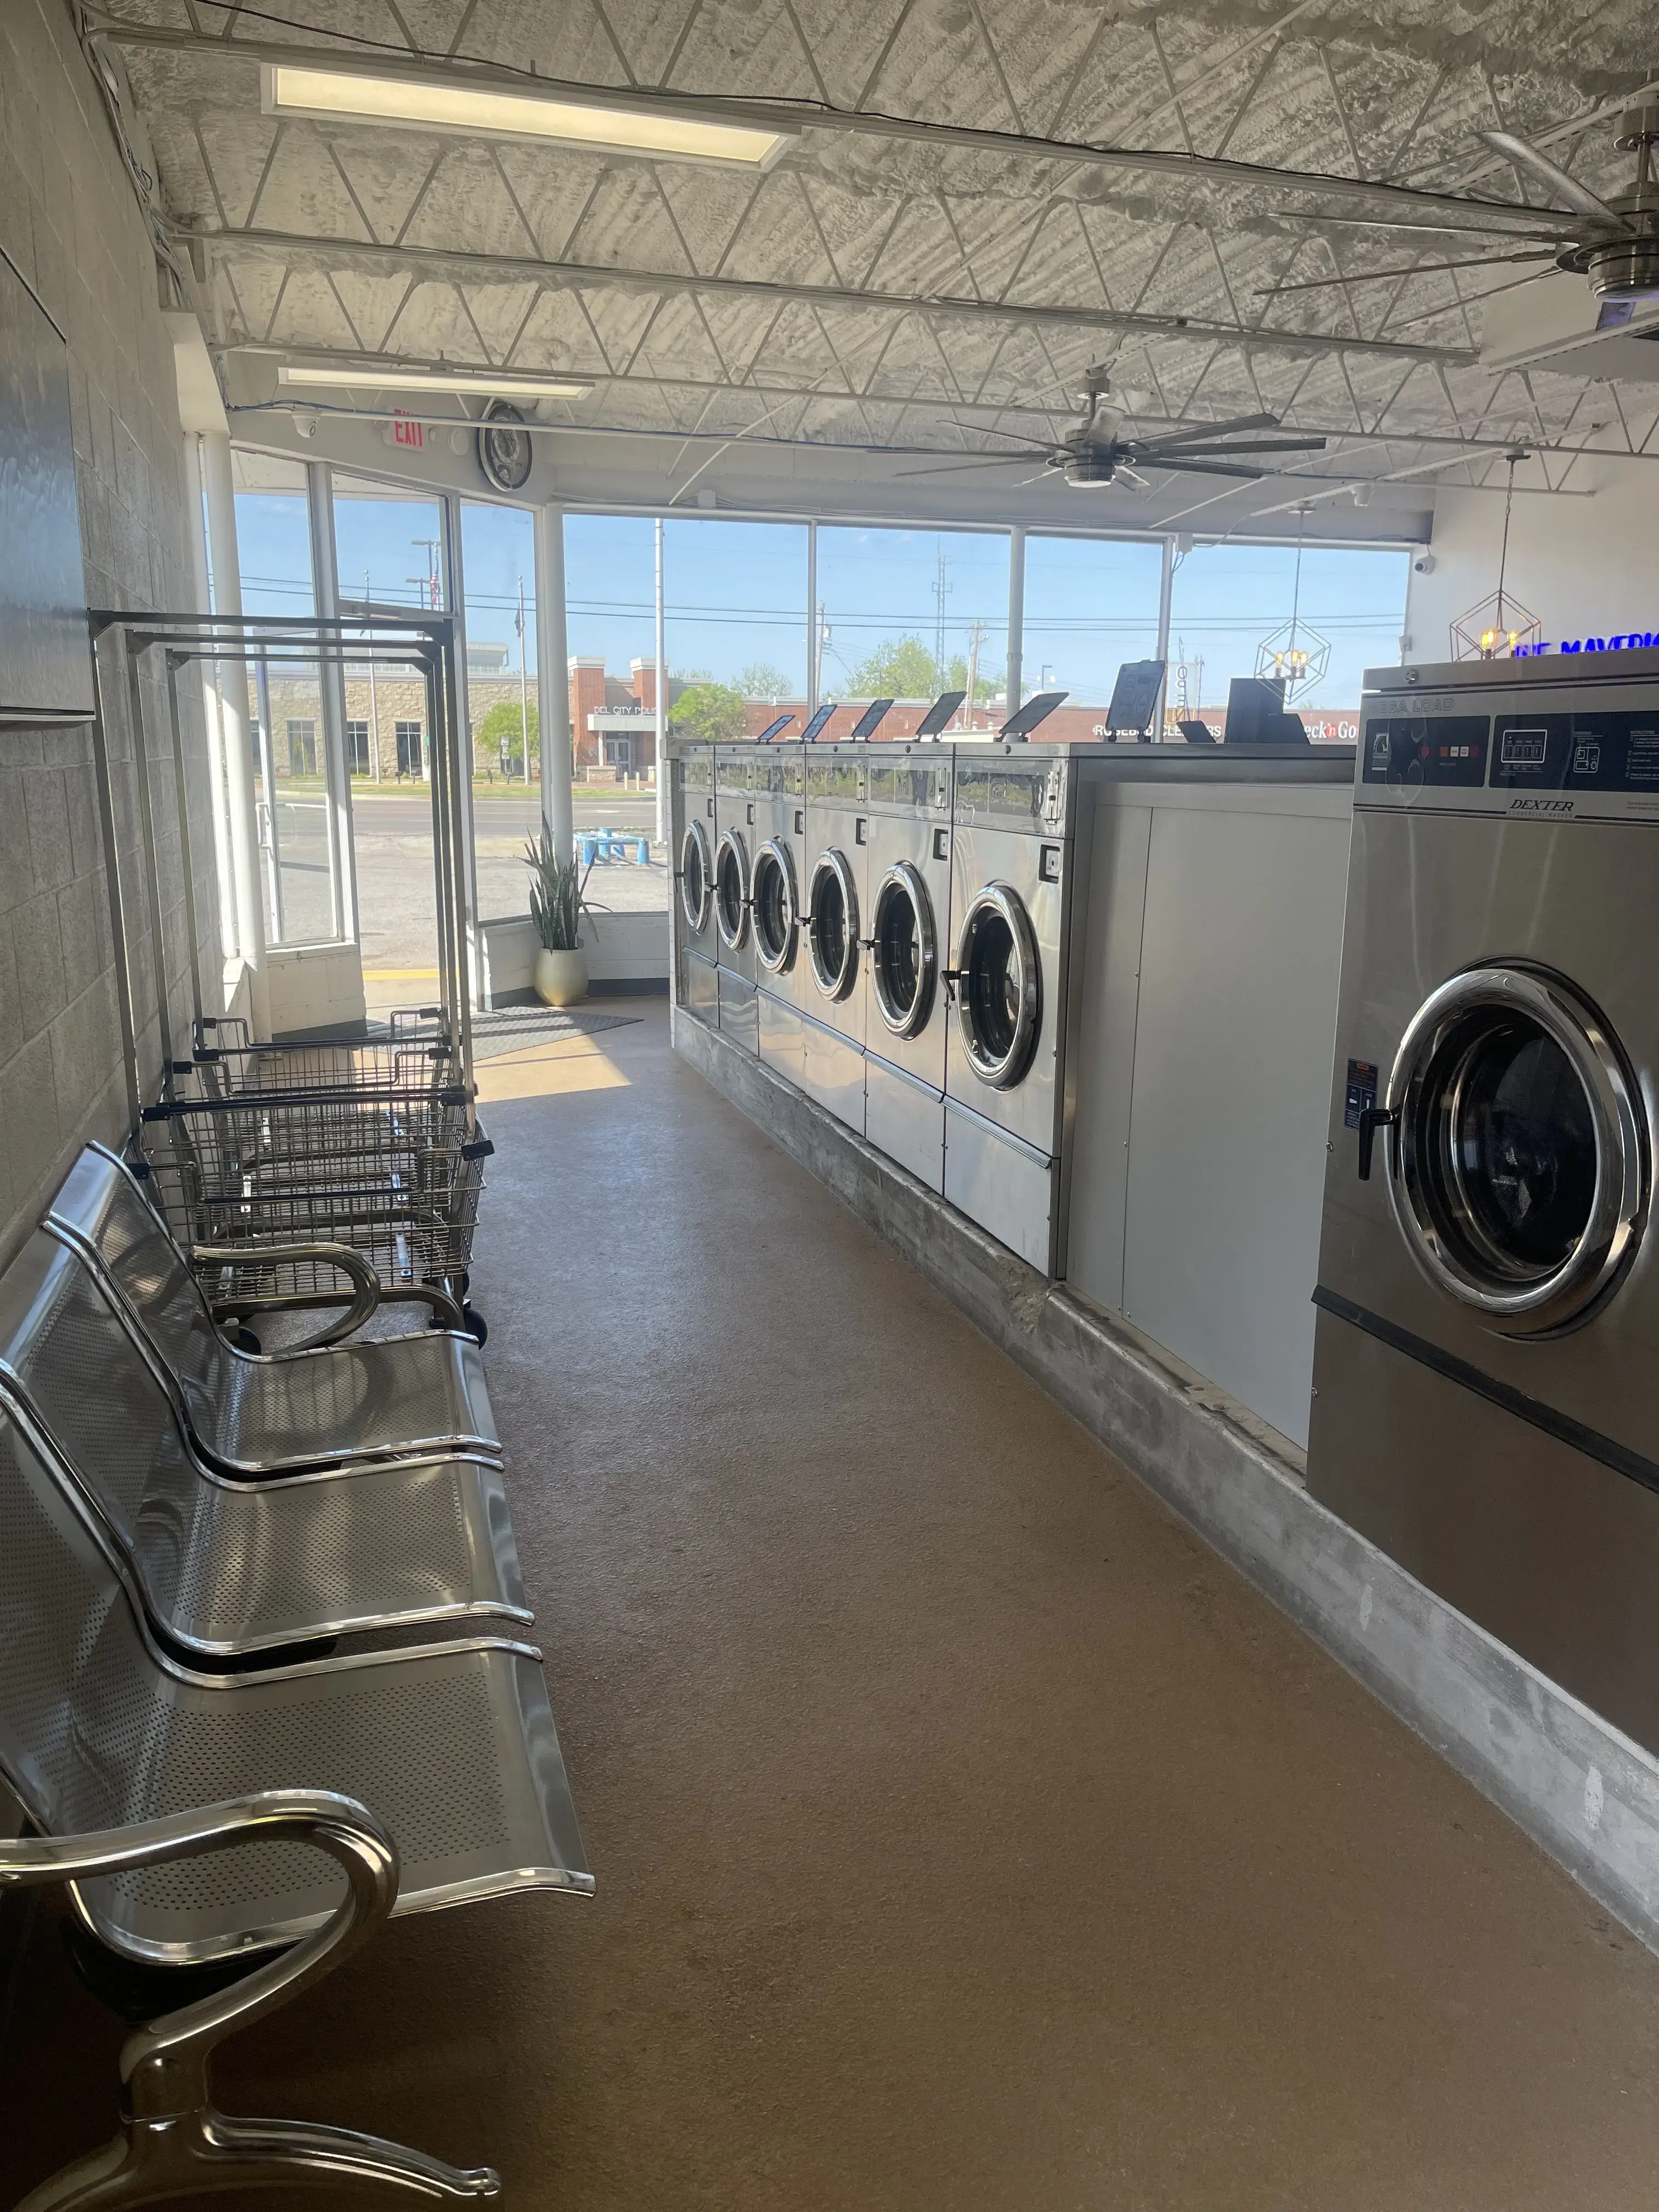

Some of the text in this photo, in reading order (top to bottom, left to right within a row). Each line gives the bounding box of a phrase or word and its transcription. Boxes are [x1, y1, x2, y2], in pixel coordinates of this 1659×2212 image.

[394, 409, 423, 447] EXIT
[613, 706, 631, 714] CITY
[1368, 698, 1453, 713] MEGA LOAD
[1338, 721, 1357, 738] Go
[1509, 799, 1574, 811] DEXTER
